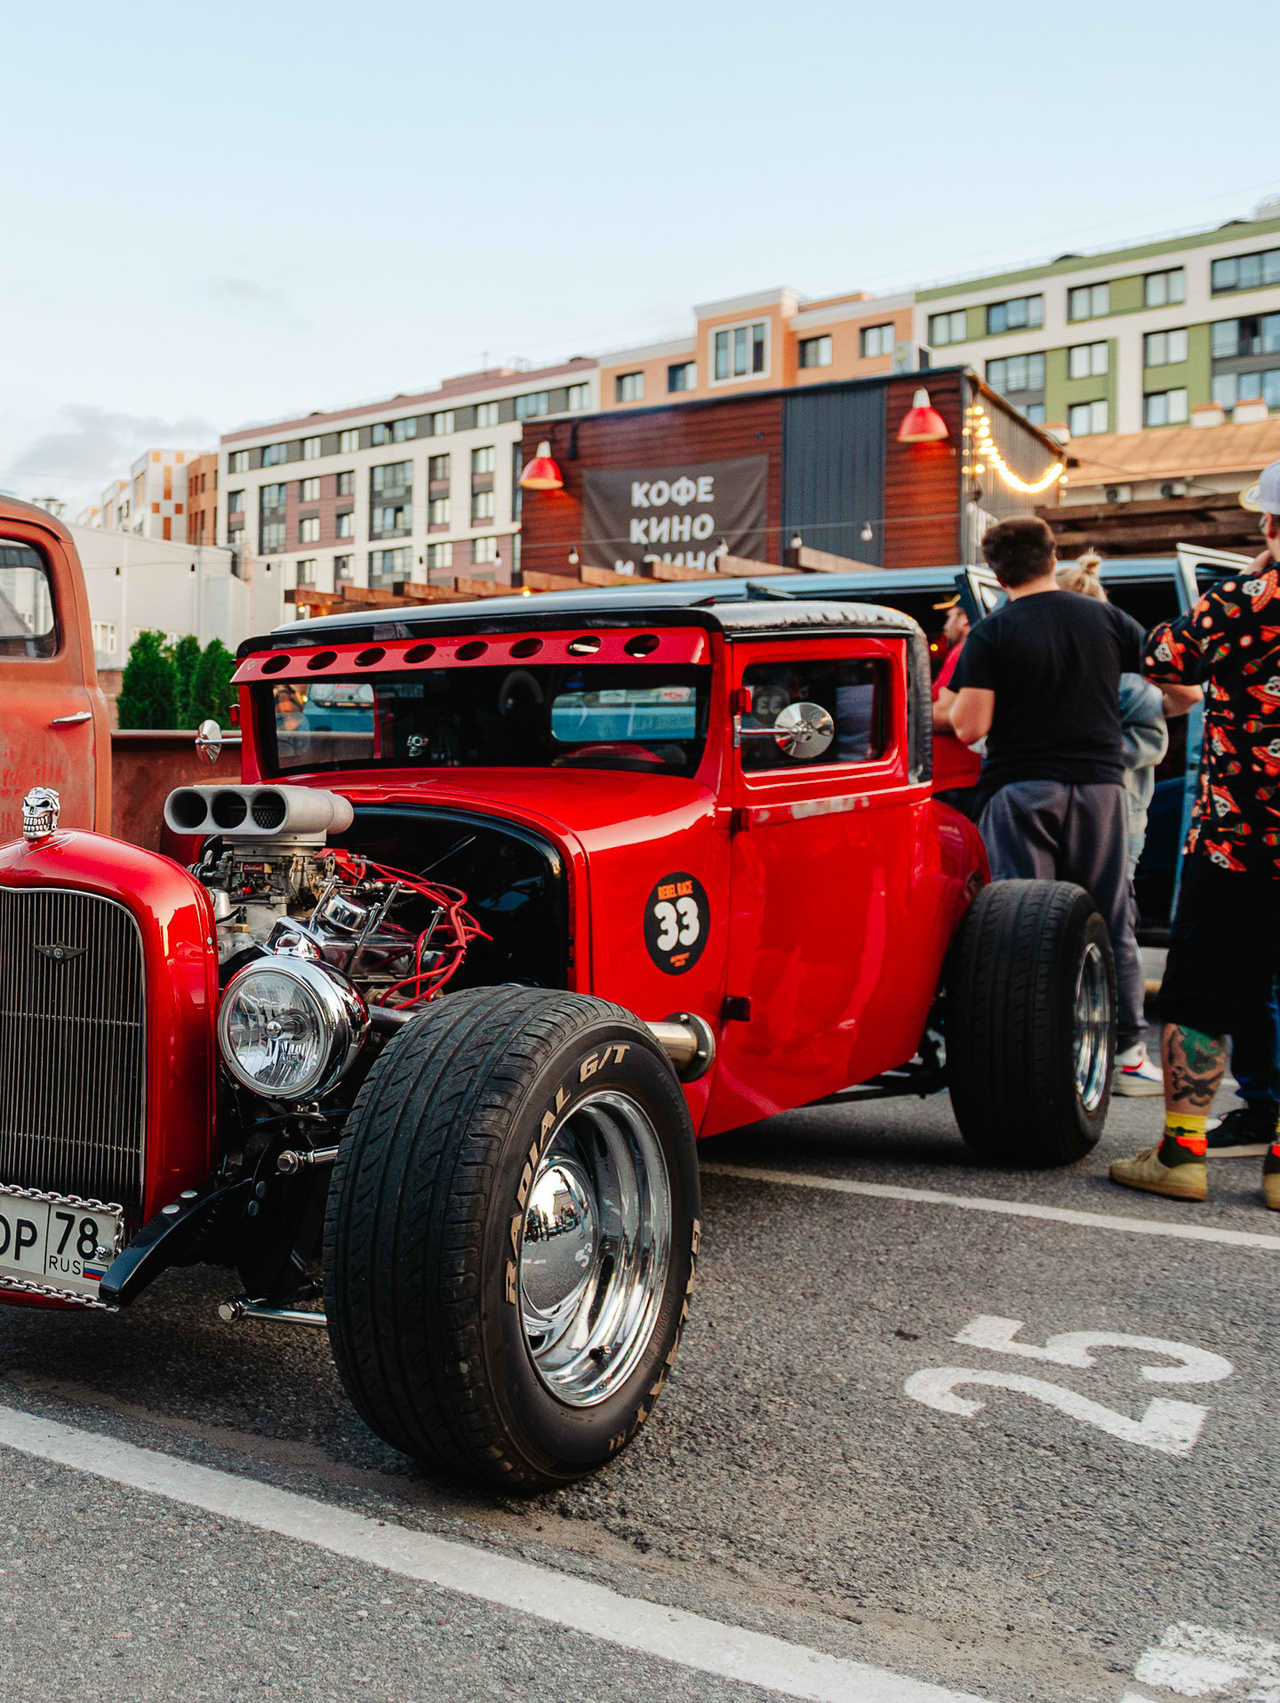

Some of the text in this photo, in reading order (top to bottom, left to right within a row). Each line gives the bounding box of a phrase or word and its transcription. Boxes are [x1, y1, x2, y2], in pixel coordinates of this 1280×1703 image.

[630, 475, 715, 508] КОФЕ
[629, 513, 715, 545] КИНО
[653, 896, 700, 952] 33
[504, 1044, 631, 1306] RADIAL G/T
[55, 1211, 100, 1261] 78
[48, 1255, 82, 1276] RUS
[903, 1314, 1235, 1458] 25
